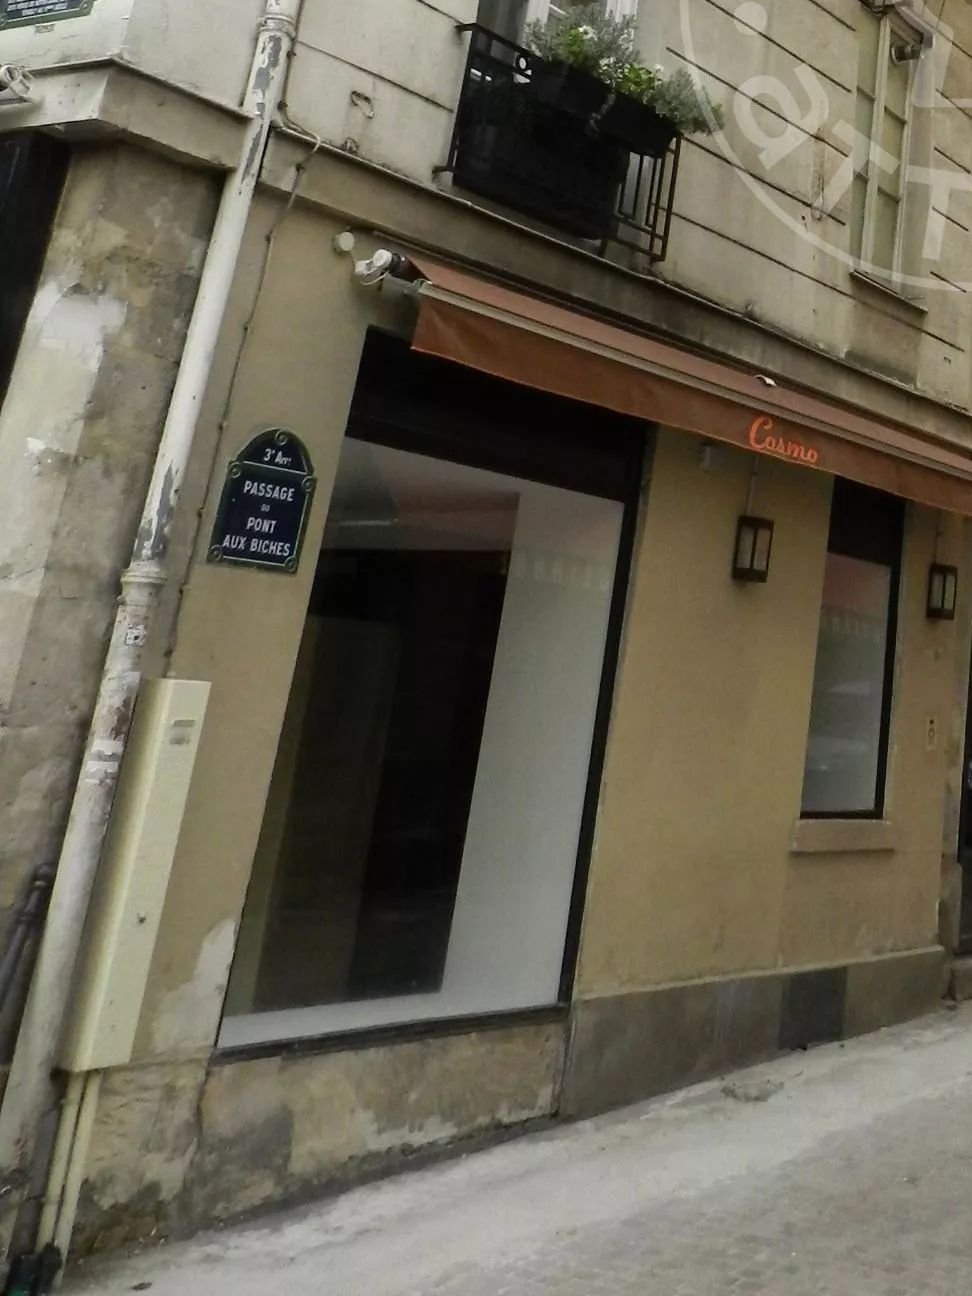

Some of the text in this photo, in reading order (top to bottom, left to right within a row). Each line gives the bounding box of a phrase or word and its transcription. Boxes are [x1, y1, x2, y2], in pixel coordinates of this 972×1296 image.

[749, 415, 819, 463] Cosmo
[243, 480, 295, 502] PASSAGE
[246, 516, 277, 534] PONT
[222, 534, 291, 556] AUX BICHES
